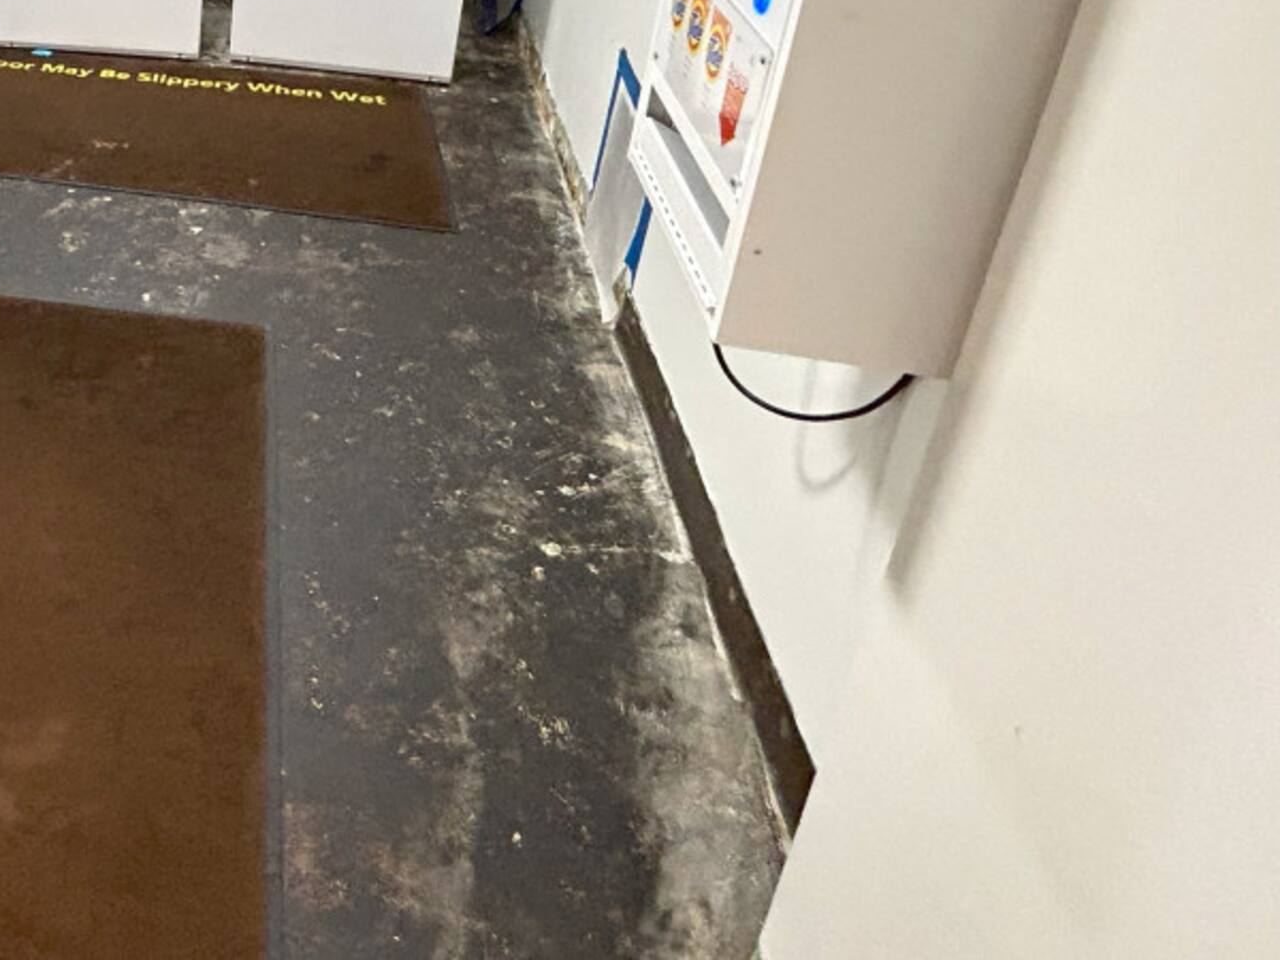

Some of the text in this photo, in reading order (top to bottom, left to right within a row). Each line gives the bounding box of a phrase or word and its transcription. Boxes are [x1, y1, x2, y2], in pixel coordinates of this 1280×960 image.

[41, 62, 95, 78] May
[99, 68, 131, 80] Be
[136, 71, 240, 92] Slippery
[246, 81, 323, 99] When
[329, 90, 387, 106] Wet
